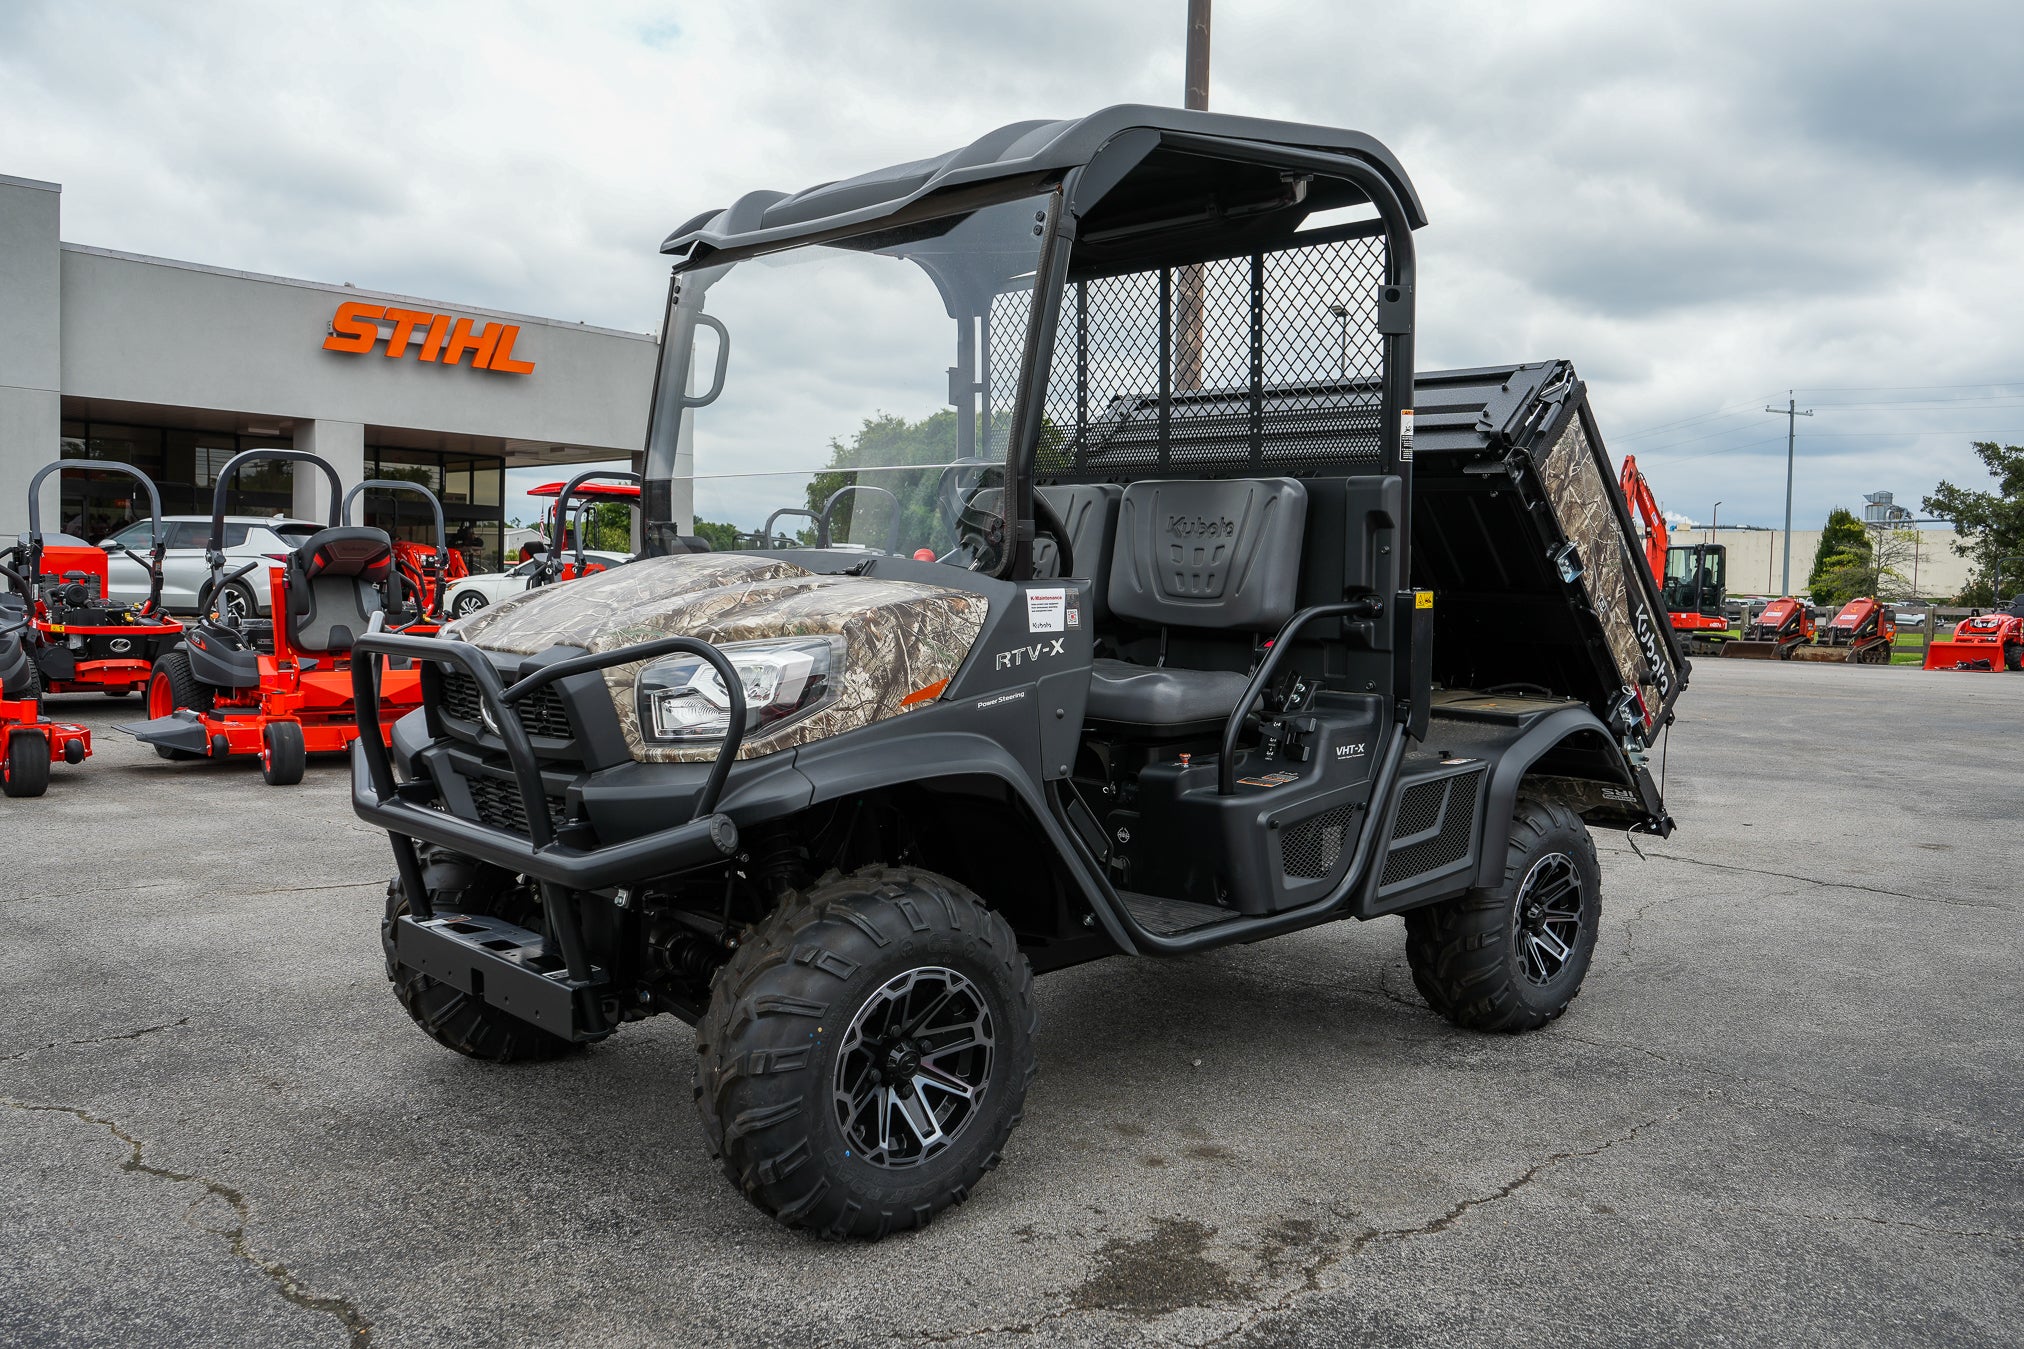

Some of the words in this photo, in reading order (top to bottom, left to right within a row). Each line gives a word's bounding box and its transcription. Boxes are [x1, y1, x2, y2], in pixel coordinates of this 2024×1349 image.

[322, 301, 535, 375] STIHL
[1166, 515, 1234, 538] Kubota
[995, 637, 1065, 671] RTV-X
[1635, 603, 1669, 696] Kubota
[977, 699, 998, 709] Power
[998, 690, 1026, 704] Steering
[1336, 743, 1365, 756] VHT-X
